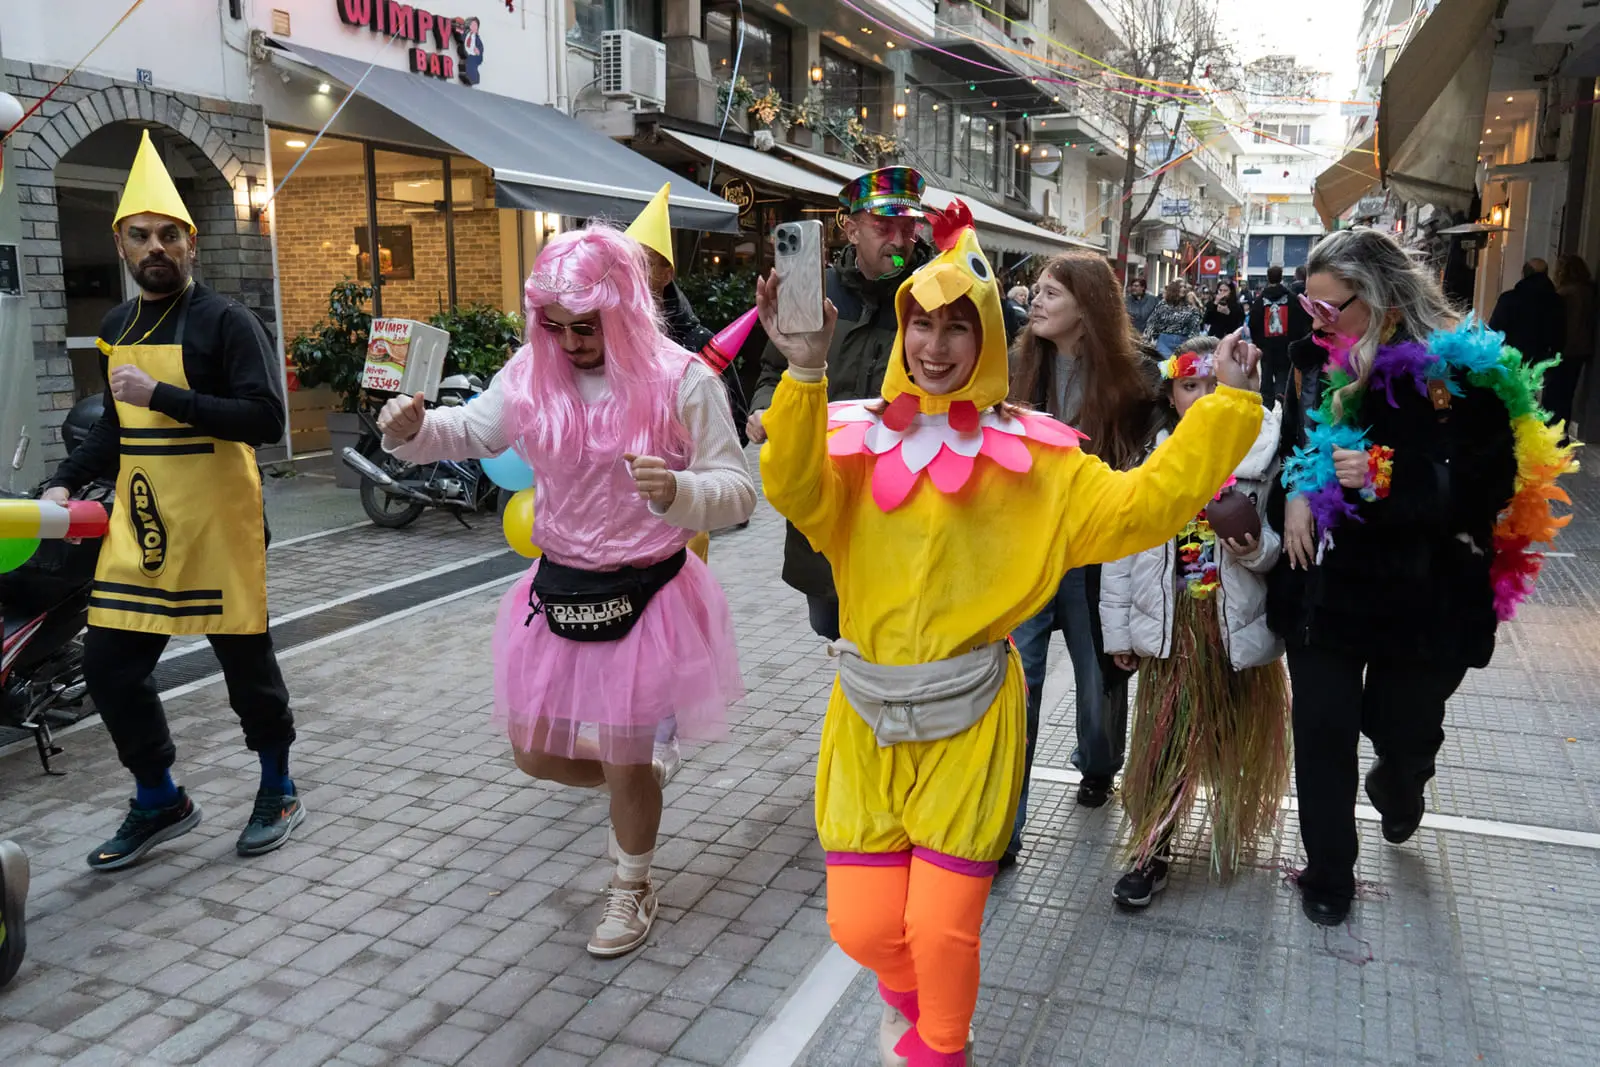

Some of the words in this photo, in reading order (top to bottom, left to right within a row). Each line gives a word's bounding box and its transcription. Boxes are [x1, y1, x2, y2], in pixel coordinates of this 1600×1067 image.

[337, 0, 451, 49] WIMPY
[140, 71, 150, 83] 12
[410, 48, 454, 79] BAR
[374, 321, 408, 334] WIMPY
[133, 480, 162, 563] CRAYON
